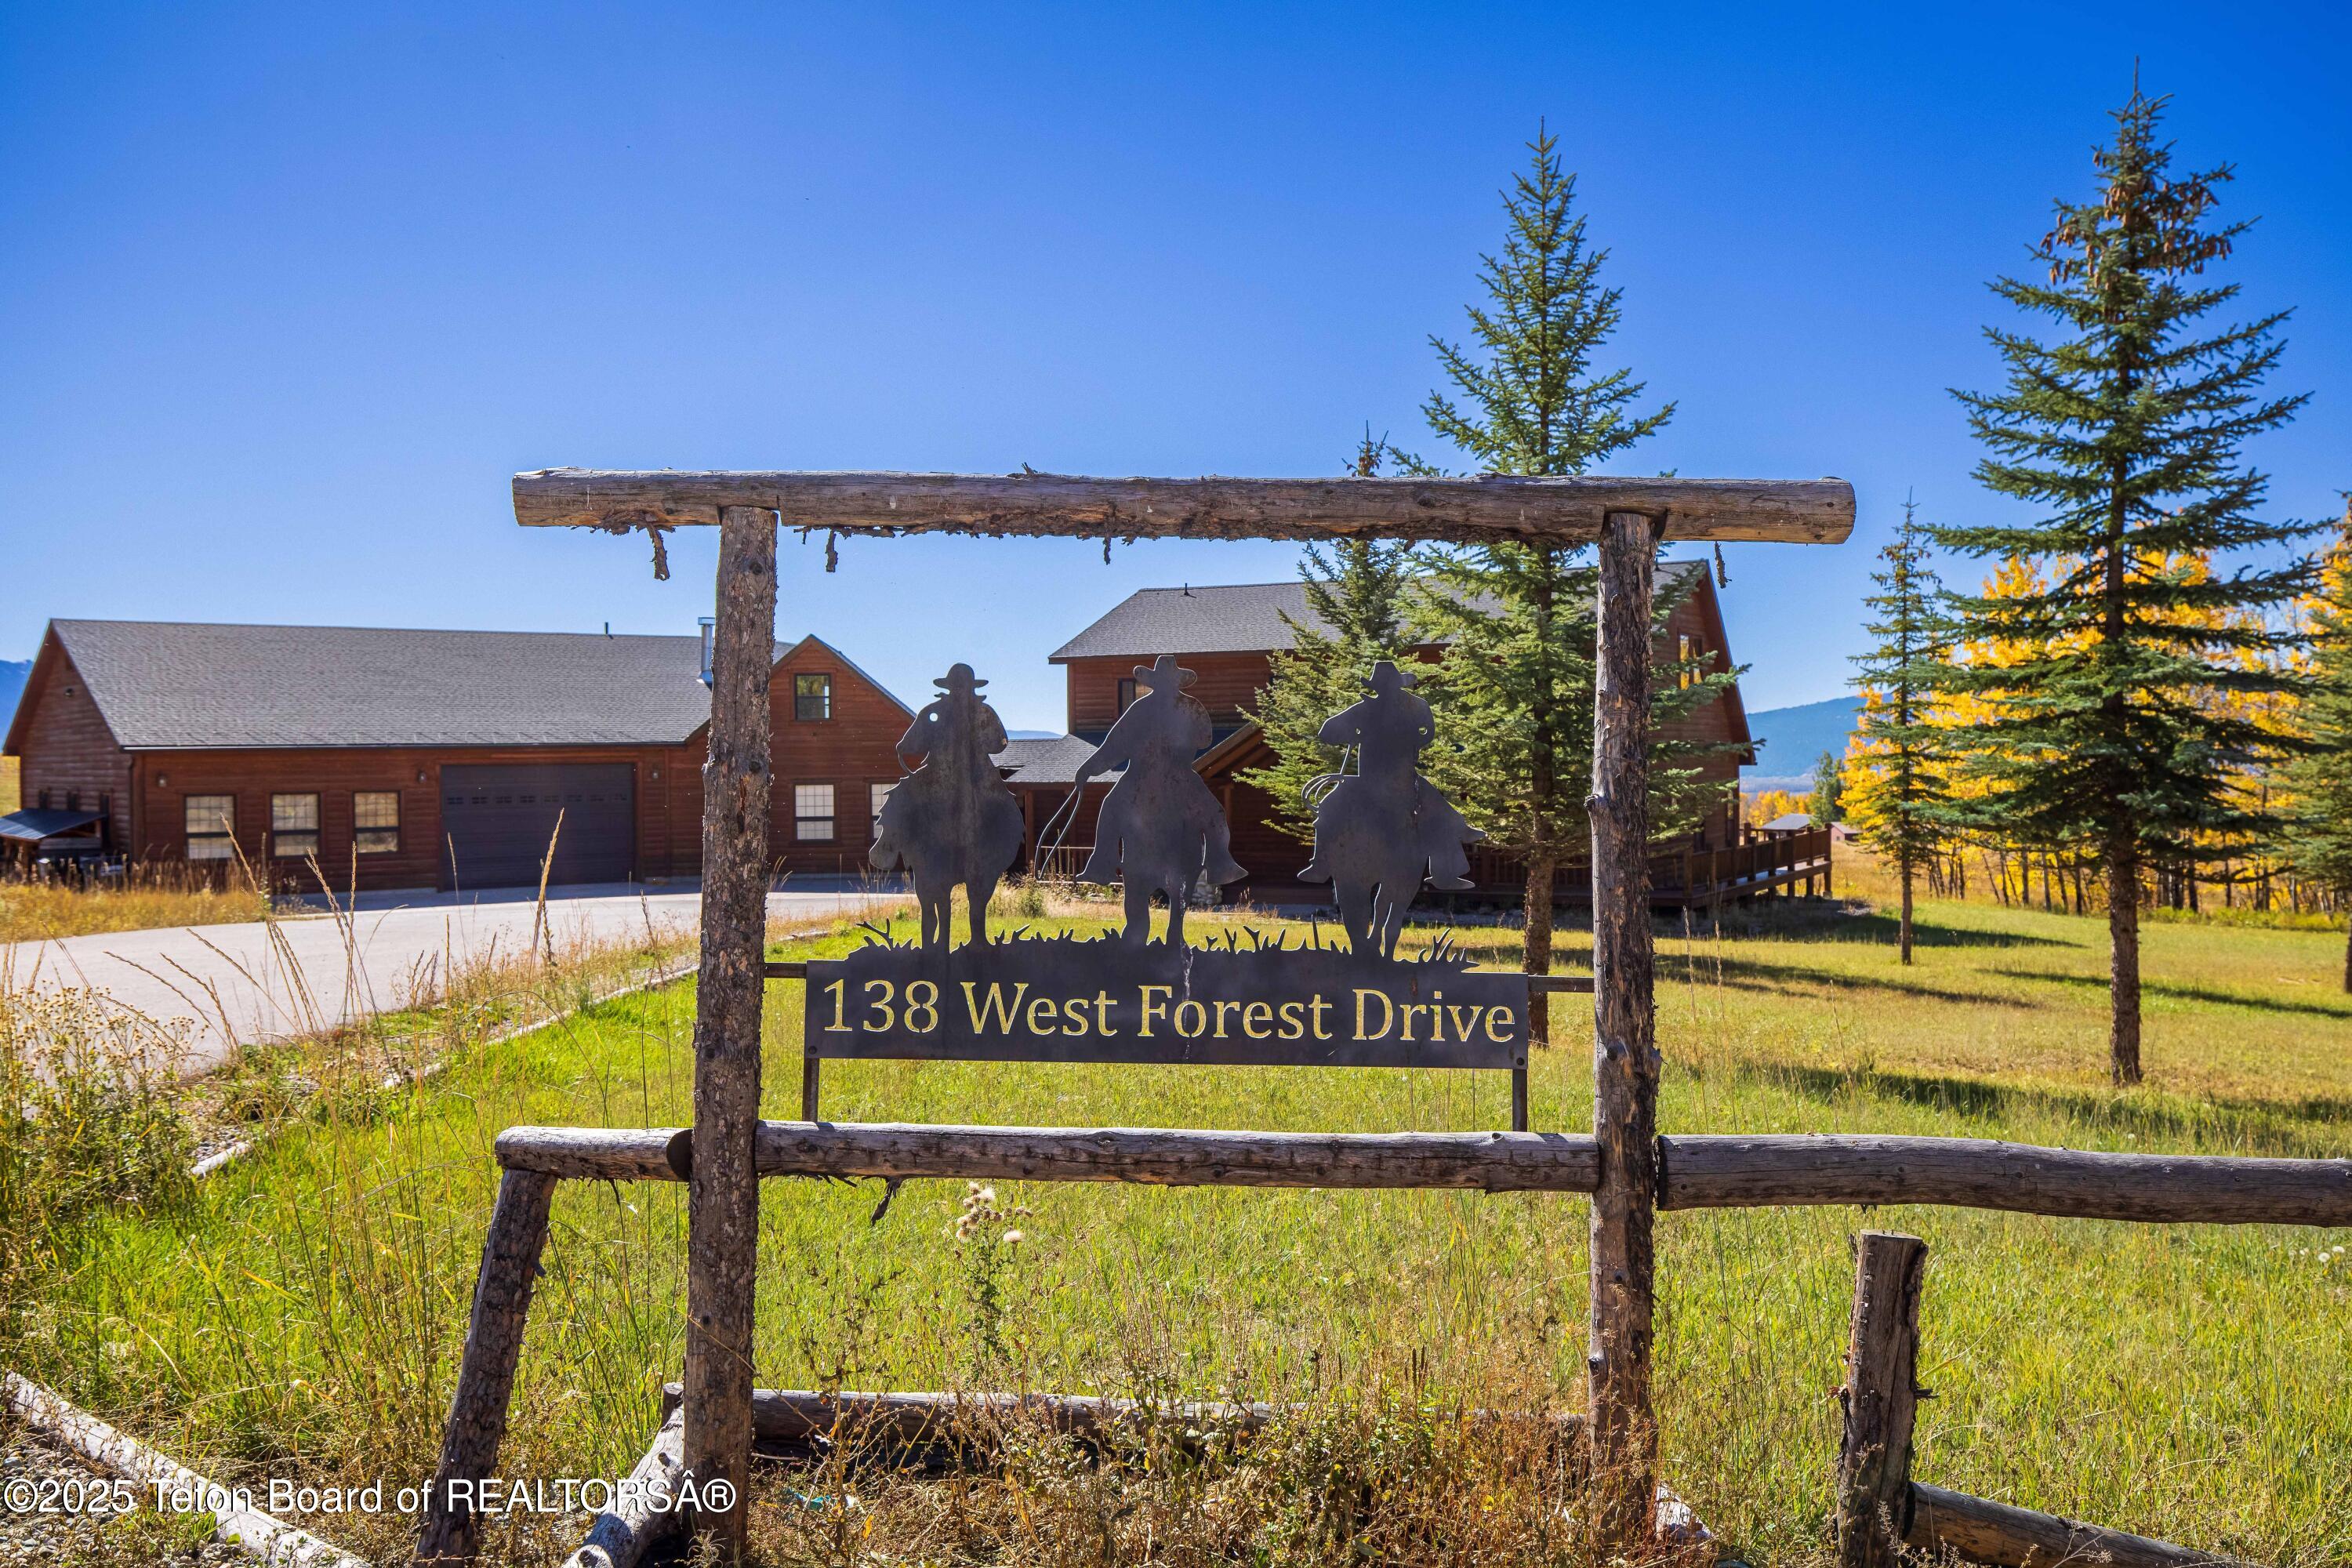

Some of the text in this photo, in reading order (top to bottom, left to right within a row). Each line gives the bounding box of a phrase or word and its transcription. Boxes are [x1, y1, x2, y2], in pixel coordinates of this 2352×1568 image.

[823, 978, 1515, 1043] 138 West Forest Drive
